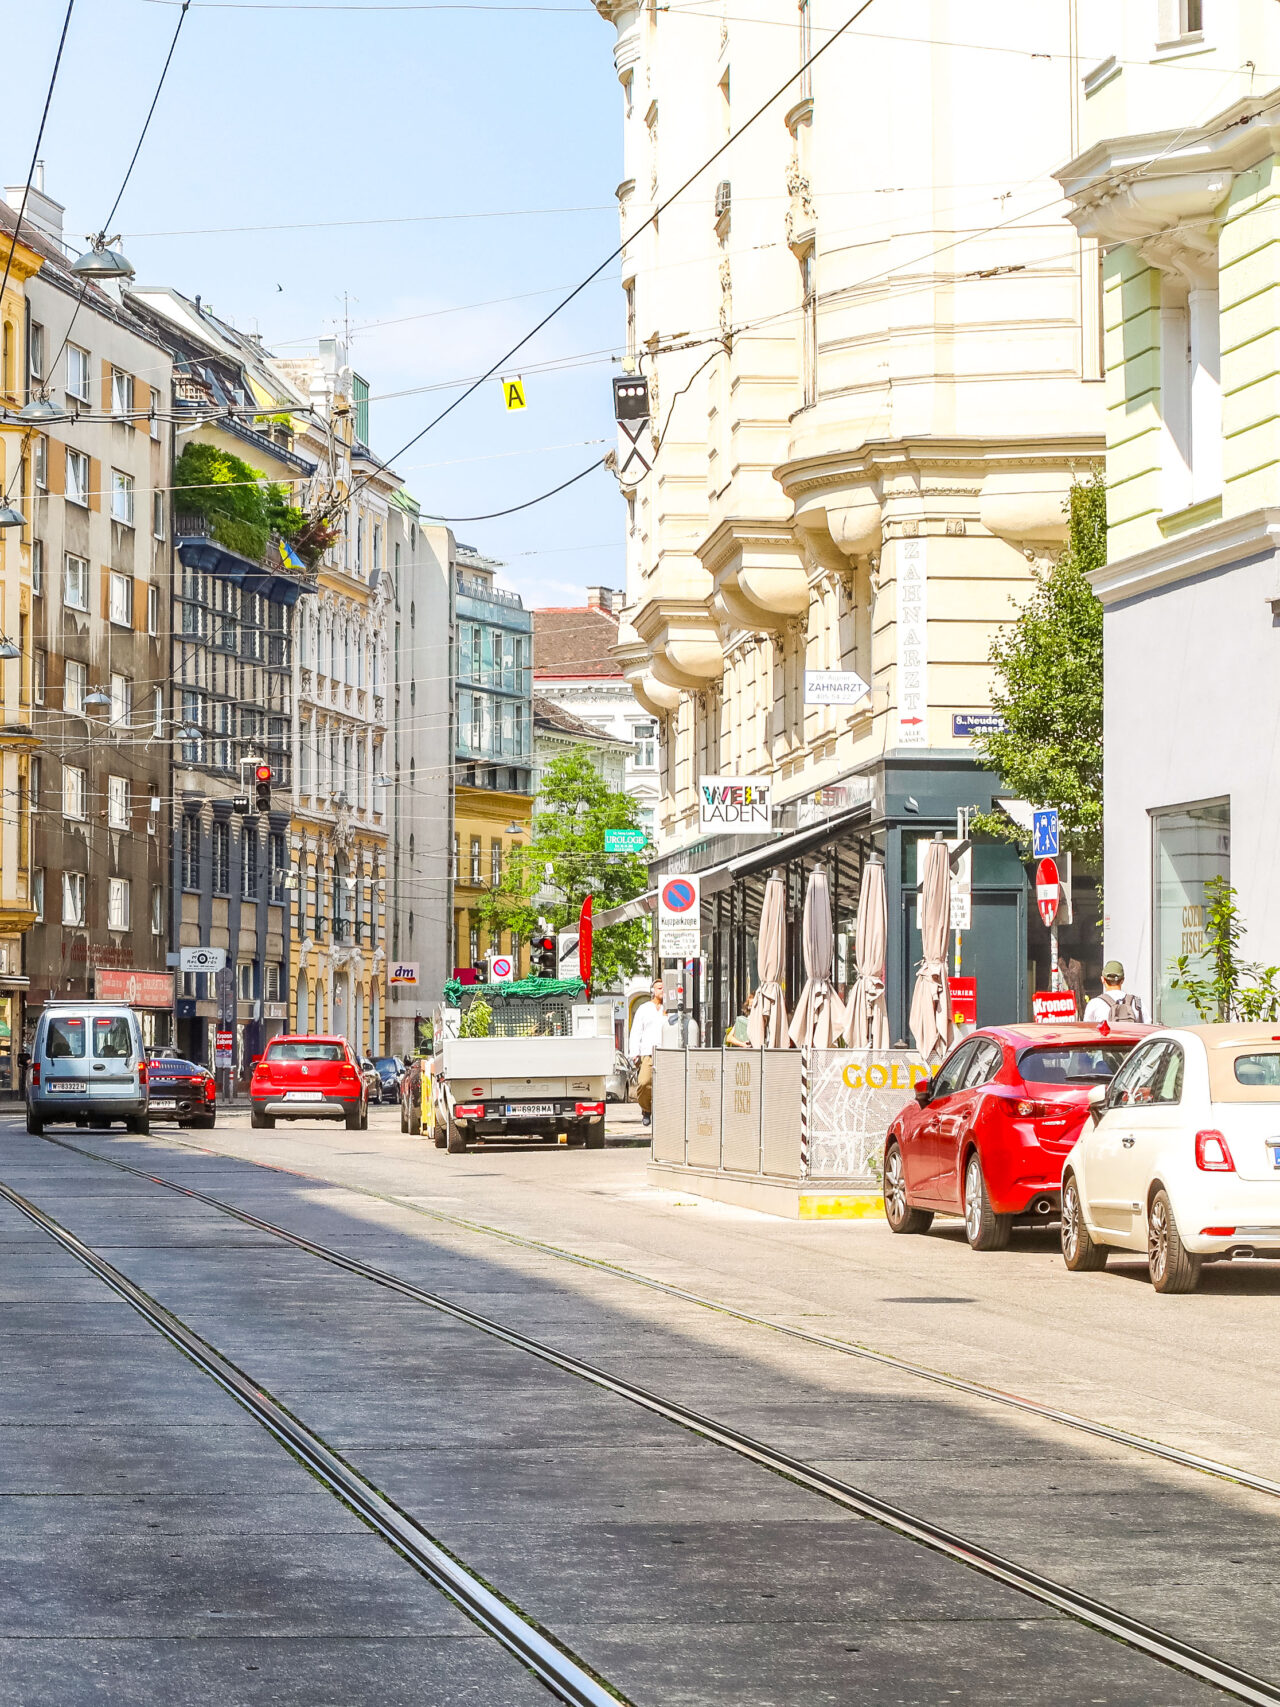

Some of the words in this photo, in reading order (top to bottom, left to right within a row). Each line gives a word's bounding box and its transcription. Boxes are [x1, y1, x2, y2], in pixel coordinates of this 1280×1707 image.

[508, 384, 524, 407] A
[902, 541, 921, 710] ZAHNARZT
[808, 682, 863, 692] ZAHNARZT
[702, 785, 769, 805] WELT
[702, 804, 769, 822] LADEN
[606, 835, 644, 844] UROLOGE
[661, 916, 697, 927] Kurzparkzone
[1182, 931, 1204, 954] FISCH
[395, 966, 414, 977] dm
[1033, 998, 1074, 1016] Kronen
[736, 1062, 751, 1087] GOLD
[842, 1063, 942, 1089] GOLD
[735, 1089, 751, 1114] FISCH
